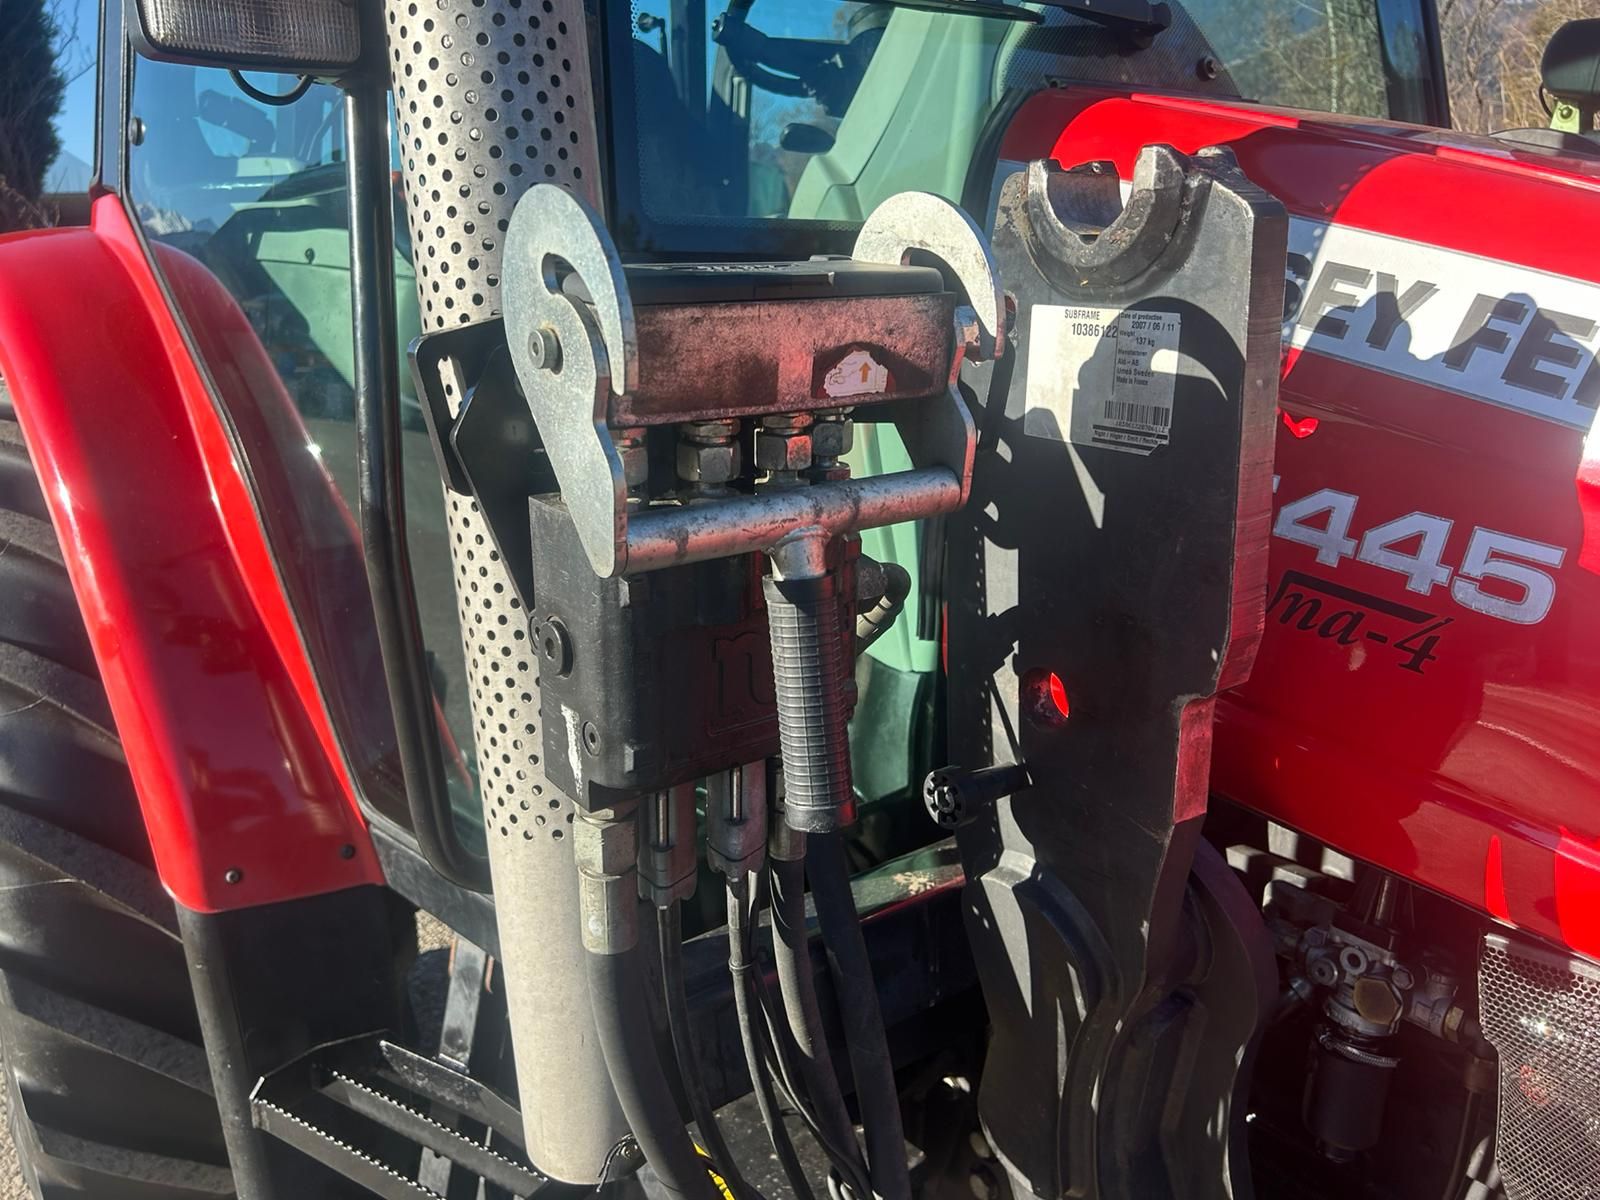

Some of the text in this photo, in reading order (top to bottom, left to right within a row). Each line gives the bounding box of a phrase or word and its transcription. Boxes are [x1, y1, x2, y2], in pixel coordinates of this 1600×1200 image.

[1065, 309, 1100, 320] SUBFRAME
[1120, 312, 1162, 321] Date of production
[1072, 323, 1118, 338] 10386122
[1132, 321, 1147, 330] 2007
[1167, 323, 1175, 332] 11
[1119, 330, 1136, 338] Weight
[1136, 336, 1155, 347] 137 kg
[1133, 368, 1155, 377] Sweden
[1116, 375, 1128, 384] Made
[1272, 475, 1567, 625] 445
